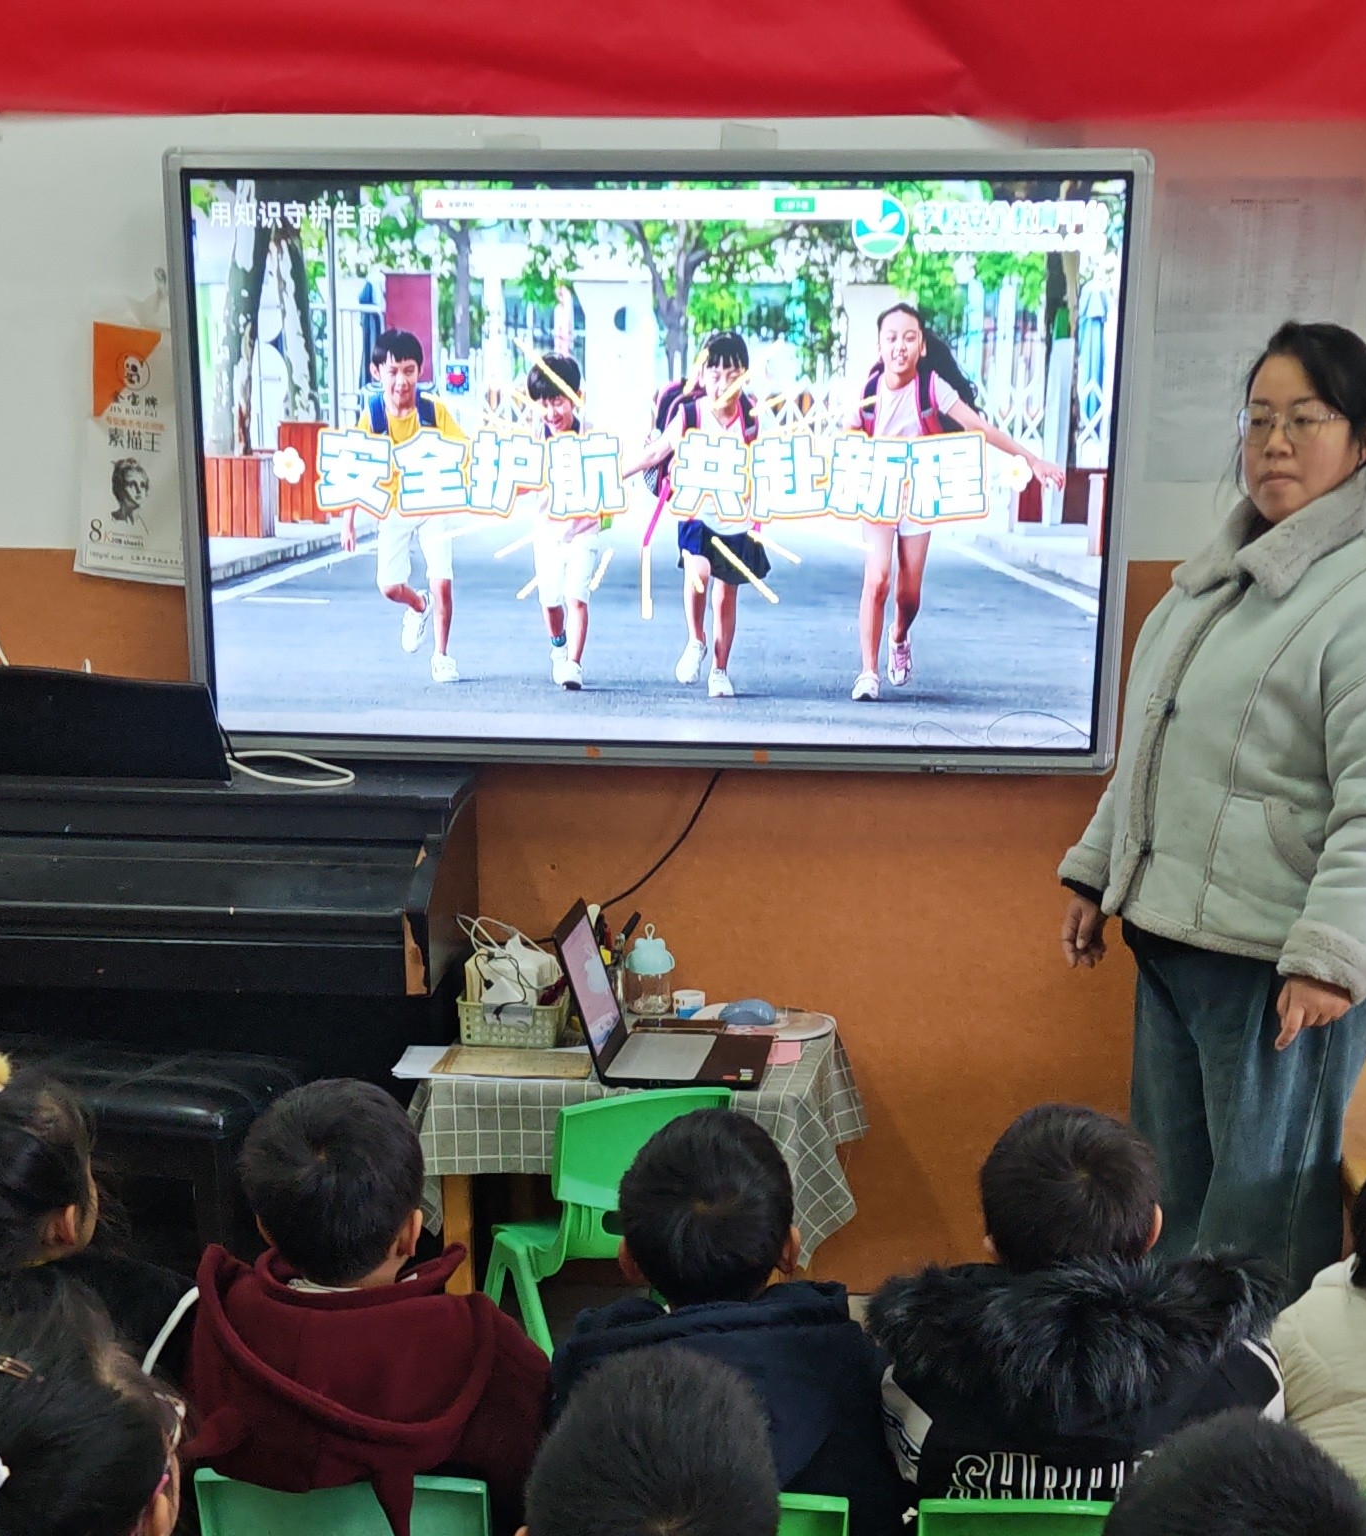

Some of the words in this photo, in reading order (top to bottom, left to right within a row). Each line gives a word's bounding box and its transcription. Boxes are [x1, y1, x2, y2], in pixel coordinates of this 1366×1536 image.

[209, 200, 382, 229] 用知识守护生命
[108, 426, 162, 453] 素描王
[317, 429, 627, 517] 安全护航
[672, 432, 987, 519] 共赴新程
